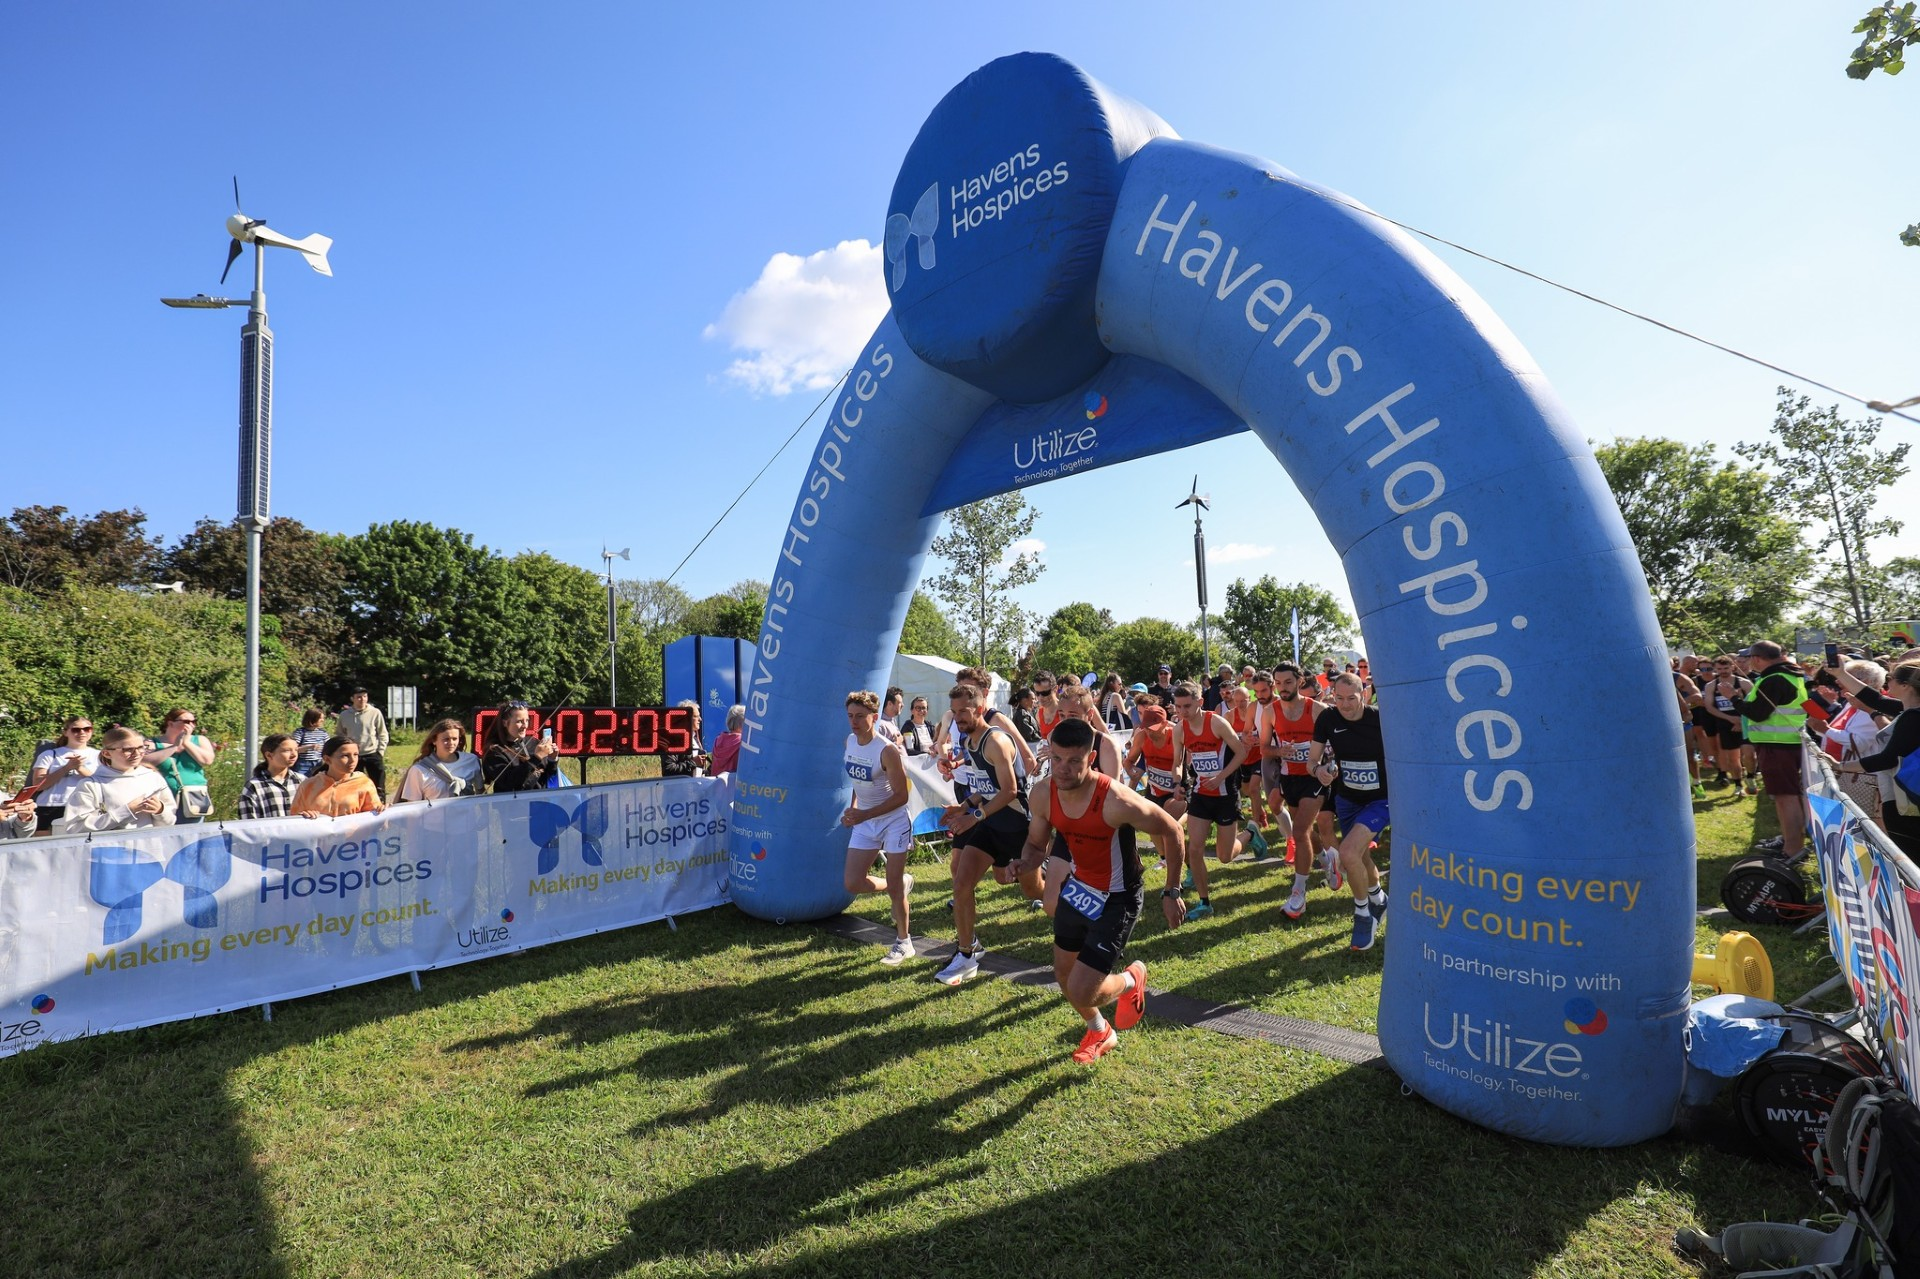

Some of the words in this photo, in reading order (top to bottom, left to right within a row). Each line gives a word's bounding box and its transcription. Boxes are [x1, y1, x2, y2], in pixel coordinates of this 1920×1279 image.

[951, 143, 1041, 210] Havens
[952, 161, 1069, 239] Hospices
[1014, 426, 1097, 469] Utilize
[1135, 193, 1363, 397] Havens
[1344, 381, 1534, 812] Hospices
[741, 577, 795, 755] Havens
[782, 343, 894, 567] Hospices
[848, 765, 867, 780] 468
[1149, 772, 1172, 788] 2495
[1195, 759, 1219, 772] 2508
[1343, 770, 1377, 783] 2660
[625, 797, 711, 825] Havens
[749, 783, 788, 803] every
[261, 832, 401, 872] Havens
[625, 817, 727, 849] Hospices
[755, 829, 773, 840] with
[260, 858, 432, 904] Hospices
[529, 872, 599, 897] Making
[603, 864, 652, 887] every
[654, 857, 685, 877] day
[1410, 843, 1523, 903] Making
[1537, 876, 1641, 912] every
[1062, 883, 1101, 918] 2497
[1410, 885, 1454, 929] day
[1461, 908, 1583, 948] count.
[84, 937, 211, 977] Making
[220, 922, 300, 952] every
[308, 912, 357, 944] day
[361, 898, 438, 928] count.
[457, 925, 509, 948] Utilize
[1423, 943, 1437, 963] In
[1442, 952, 1567, 992] partnership
[1575, 972, 1621, 991] with
[1424, 1001, 1583, 1078] Utilize
[1423, 1050, 1505, 1092] Technology.
[1766, 1107, 1830, 1124] MYLA
